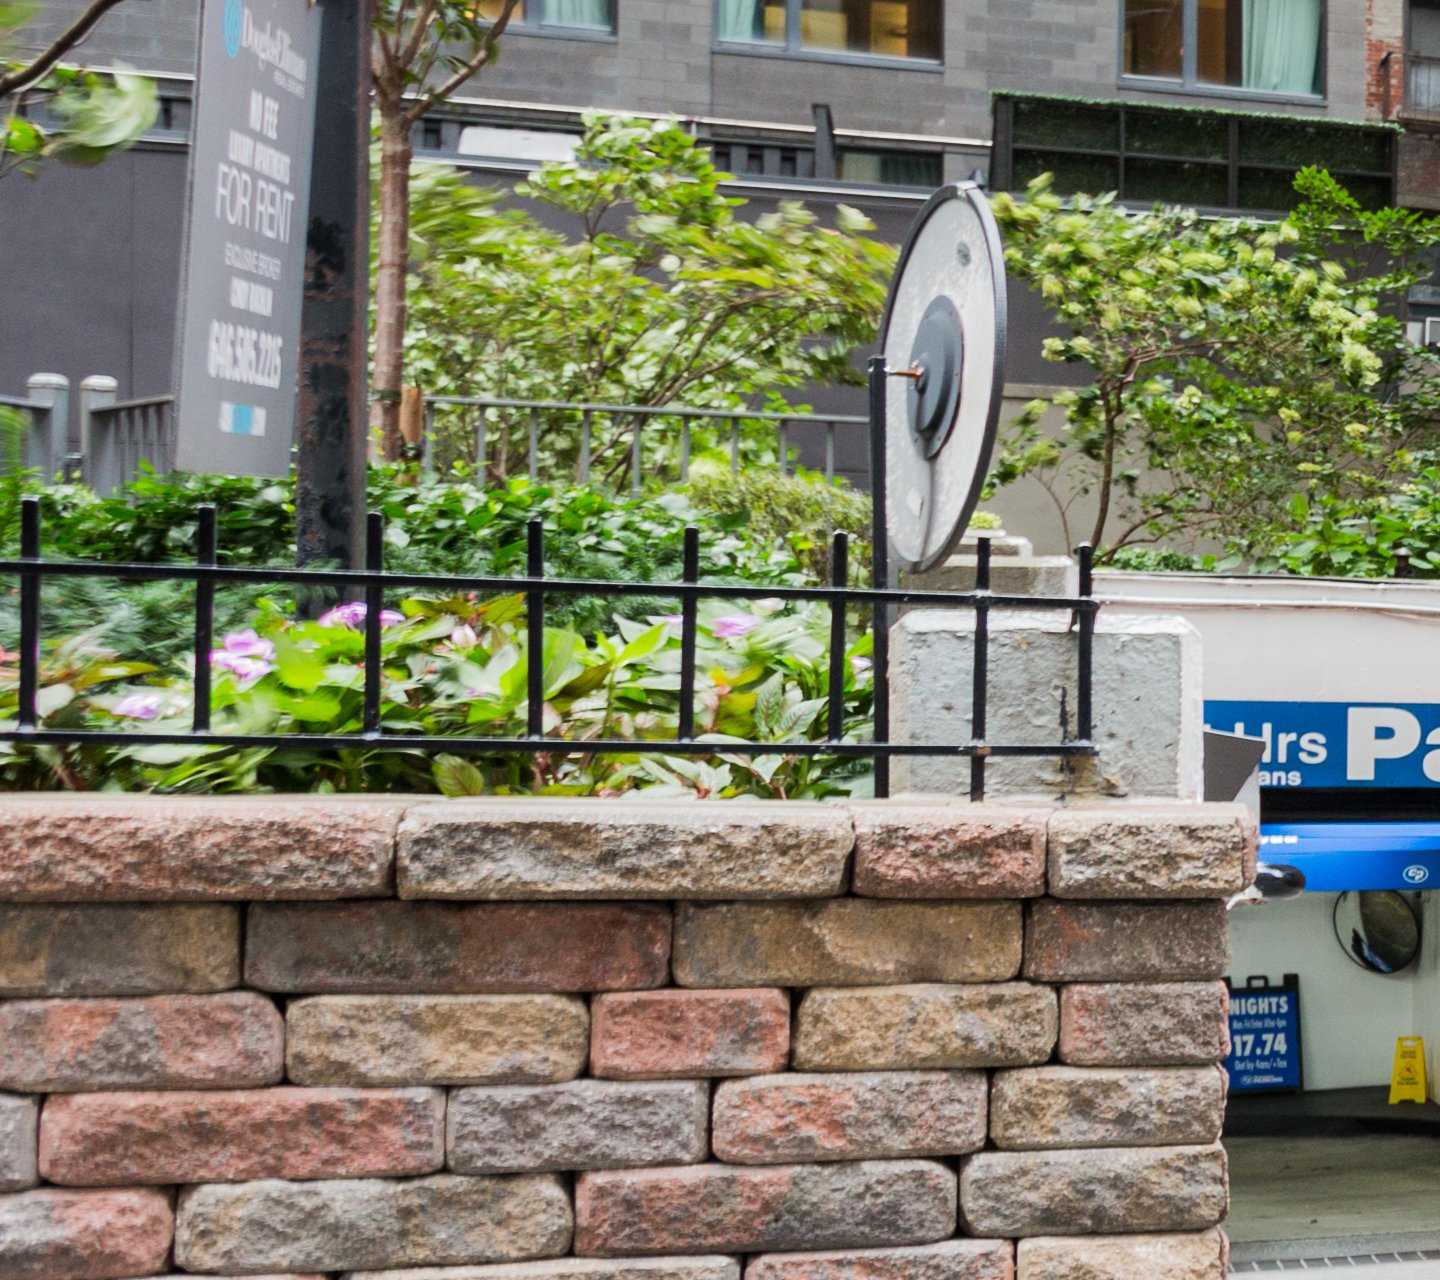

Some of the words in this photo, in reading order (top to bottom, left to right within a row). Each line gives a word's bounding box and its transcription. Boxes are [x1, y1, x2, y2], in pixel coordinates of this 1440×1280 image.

[215, 161, 252, 228] FOR
[254, 178, 295, 244] RENT
[1229, 996, 1288, 1015] NIGHTS
[1233, 1033, 1287, 1057] 17.74
